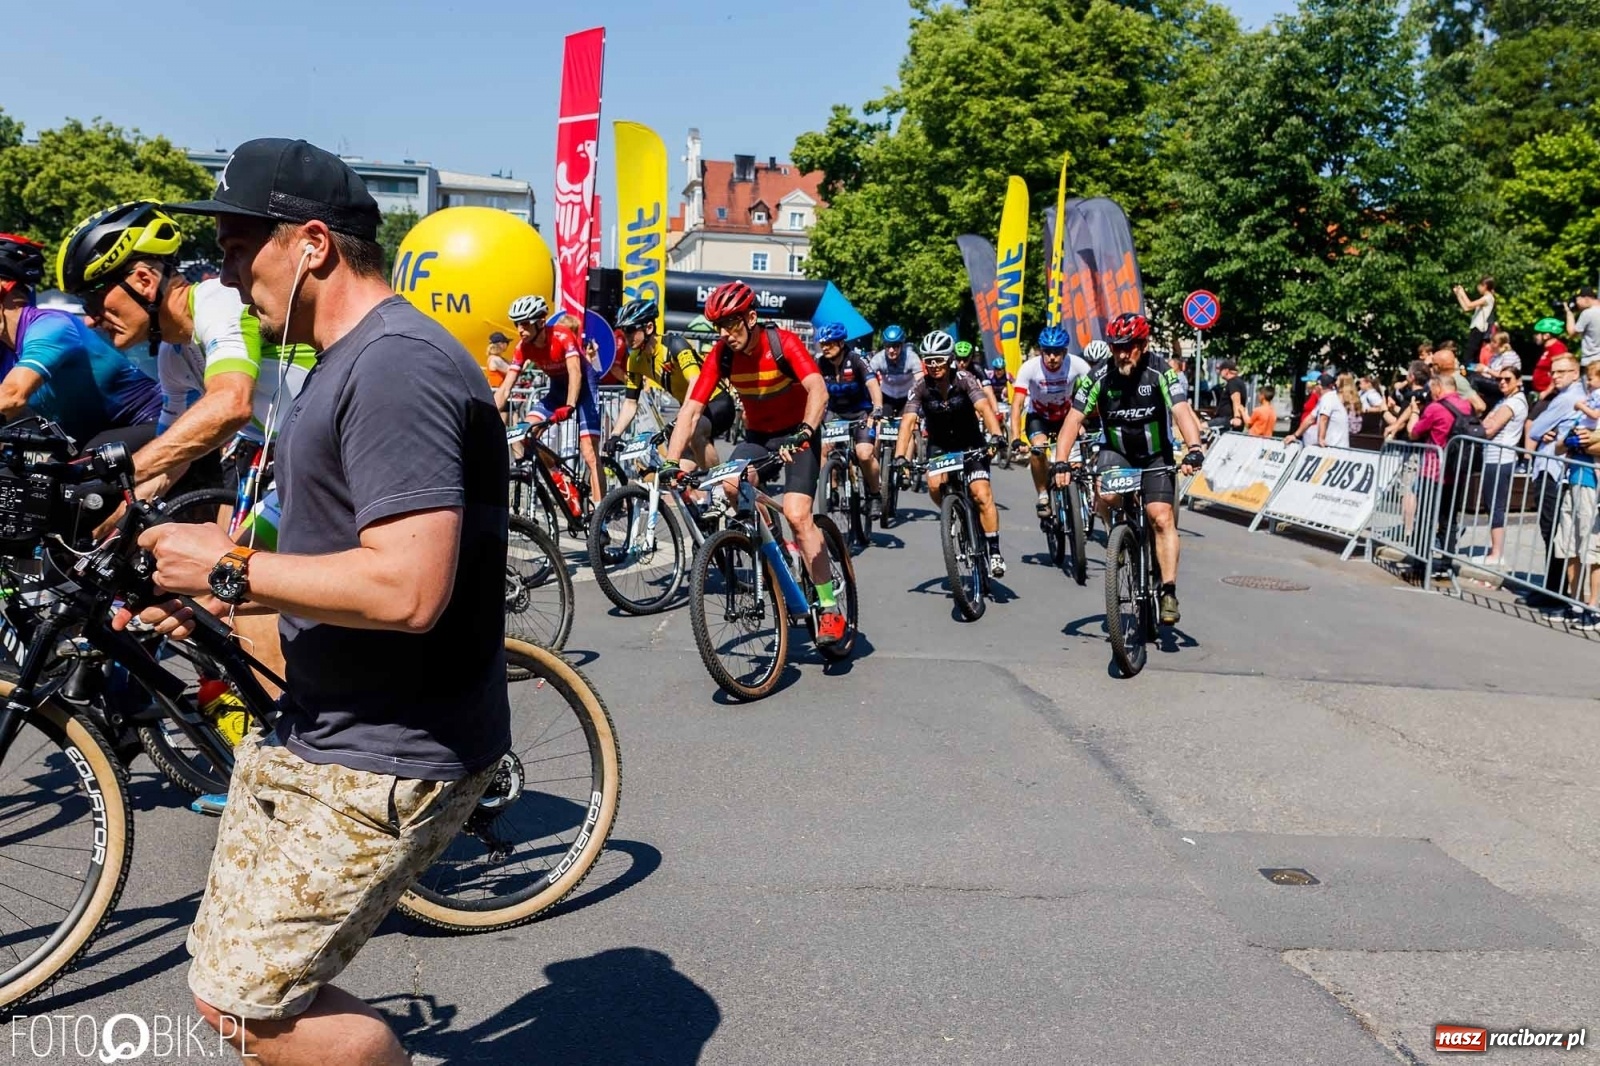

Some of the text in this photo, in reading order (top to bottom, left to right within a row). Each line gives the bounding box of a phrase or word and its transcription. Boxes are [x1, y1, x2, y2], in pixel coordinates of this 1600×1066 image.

[431, 292, 471, 314] FM
[1107, 476, 1134, 488] 1485
[65, 746, 107, 865] EQUATOR
[548, 791, 602, 883] EQUATOR
